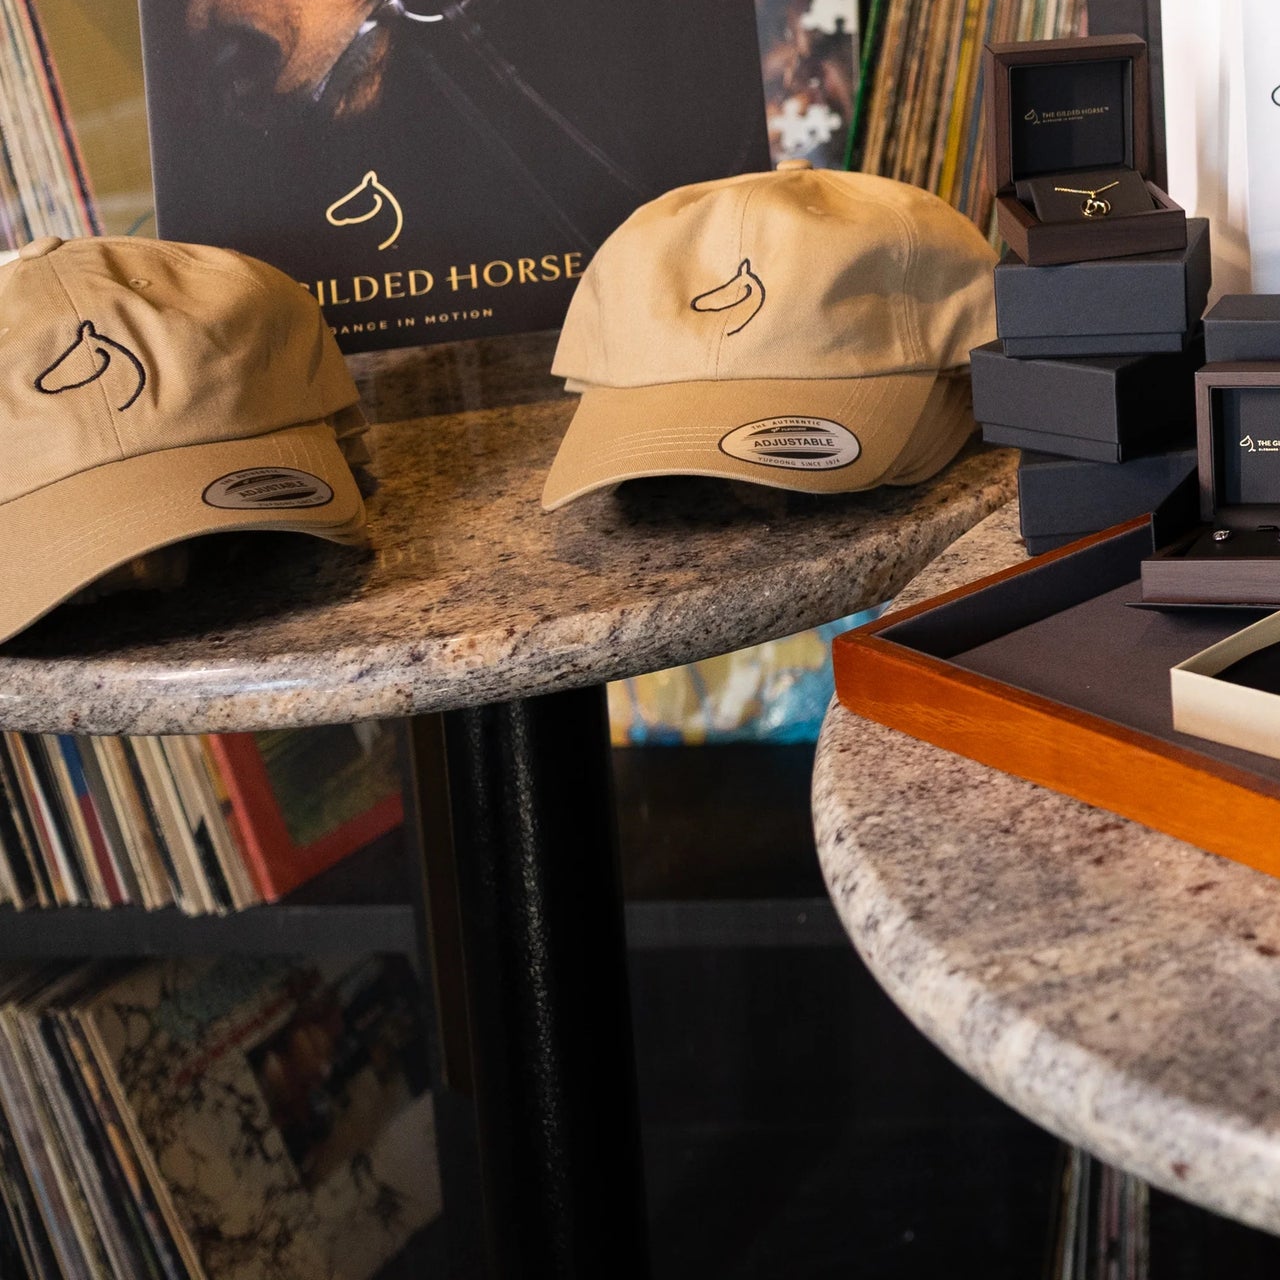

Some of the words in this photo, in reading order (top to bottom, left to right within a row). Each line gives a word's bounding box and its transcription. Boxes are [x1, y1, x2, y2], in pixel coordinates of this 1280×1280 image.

[299, 269, 434, 307] ILDED
[446, 251, 584, 292] HORSE
[397, 317, 415, 327] IN
[425, 308, 494, 325] MOTION
[751, 423, 767, 431] THE
[771, 419, 822, 427] AUTHENTIC
[753, 437, 835, 448] ADJUSTABLE
[757, 456, 797, 467] YUPOONG
[238, 480, 309, 499] ADJUSTABLE
